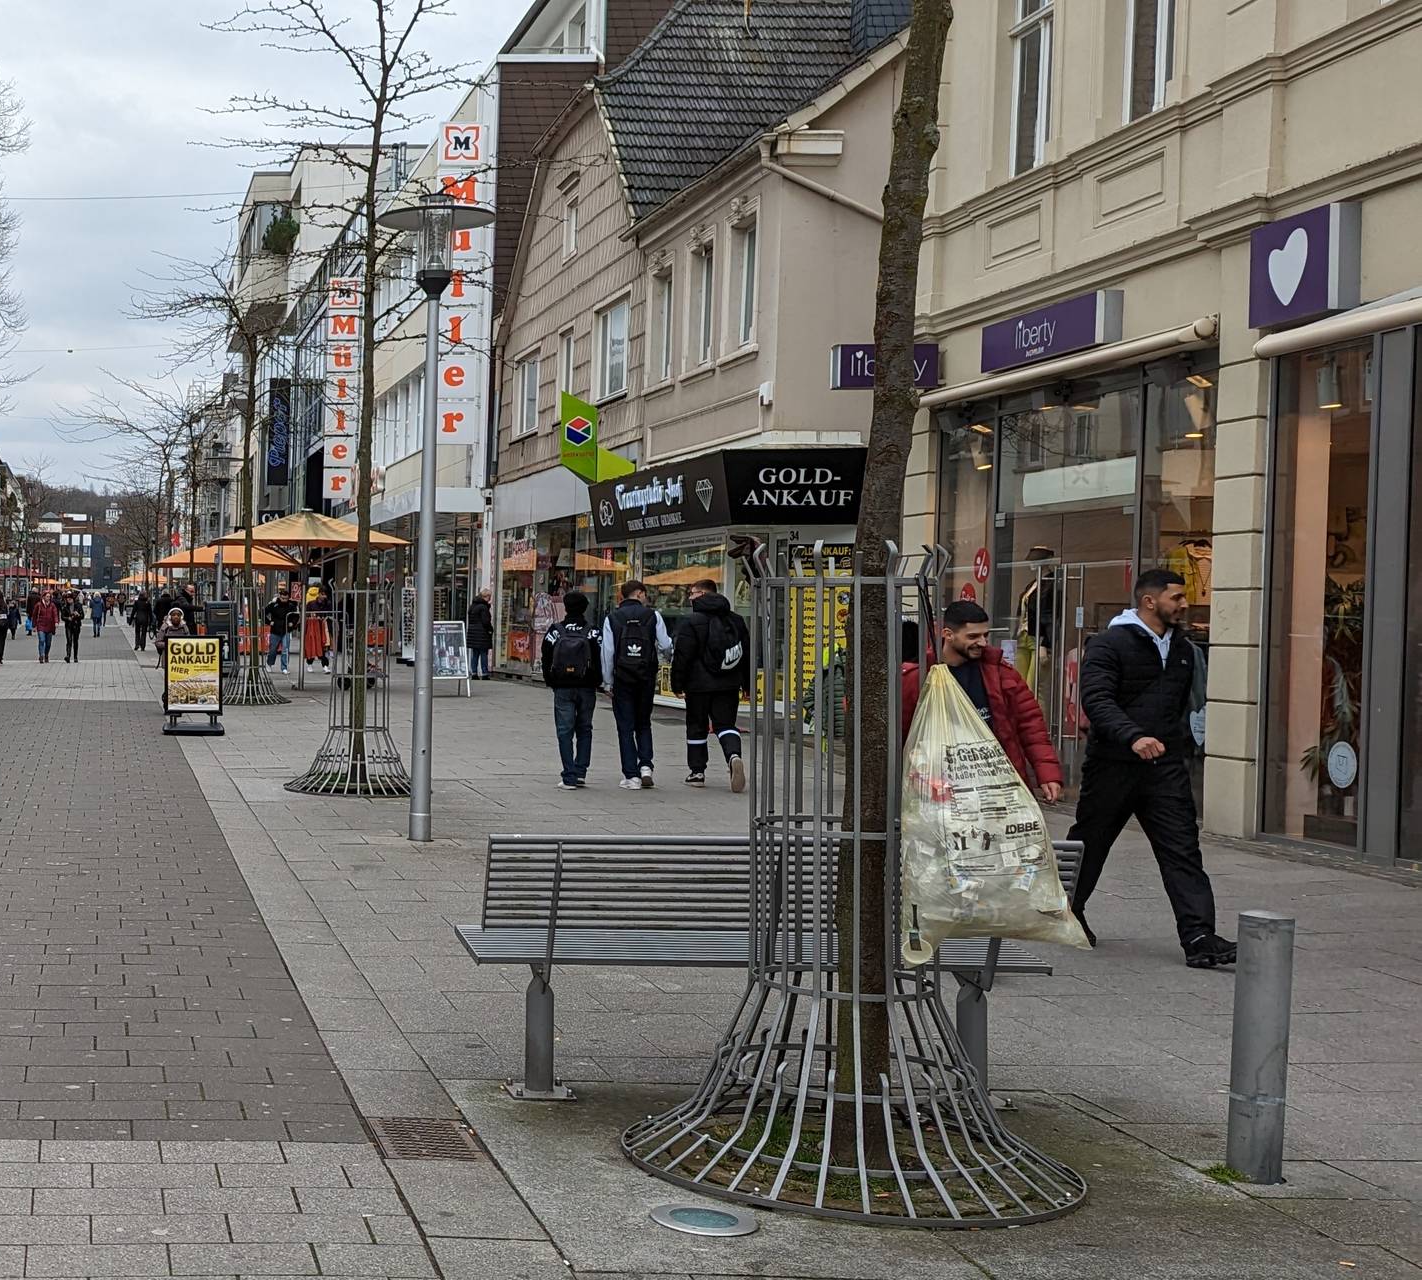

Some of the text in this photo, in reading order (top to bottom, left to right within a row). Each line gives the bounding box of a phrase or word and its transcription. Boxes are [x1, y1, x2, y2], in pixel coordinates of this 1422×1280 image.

[453, 136, 470, 150] M
[1015, 318, 1056, 350] liberty
[850, 350, 928, 381] liby
[331, 315, 356, 491] Müller
[758, 467, 841, 485] GOLD-
[742, 489, 854, 506] ANKAUF
[789, 530, 799, 541] 34
[170, 642, 216, 655] GOLD
[170, 655, 217, 665] ANKAUF
[171, 666, 190, 675] HIER
[1005, 821, 1041, 835] LOBBE
